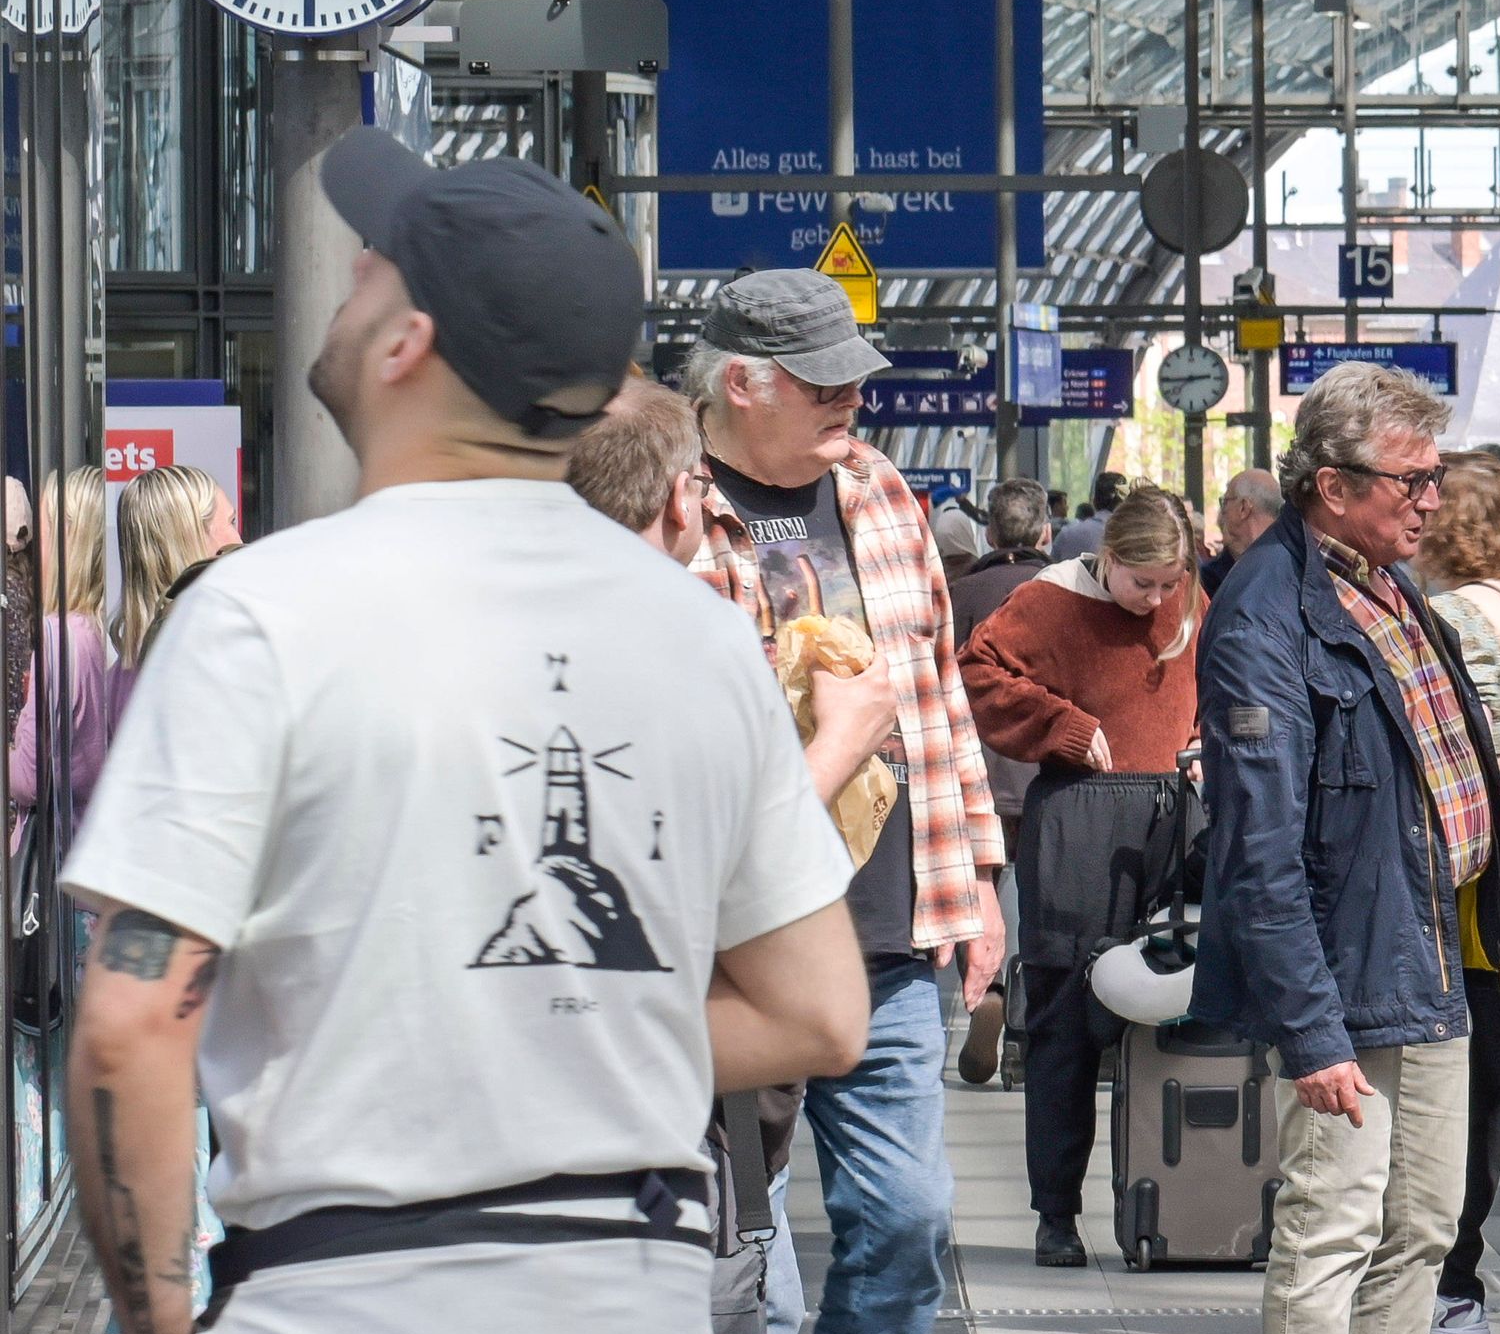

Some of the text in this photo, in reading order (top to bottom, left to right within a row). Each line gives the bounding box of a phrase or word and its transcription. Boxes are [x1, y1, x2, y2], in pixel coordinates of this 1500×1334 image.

[713, 149, 770, 169] Alles
[778, 150, 823, 174] gut,
[870, 147, 920, 169] hast
[927, 146, 962, 169] bei
[1346, 246, 1393, 287] 15
[1327, 347, 1394, 360] Flughafen BER
